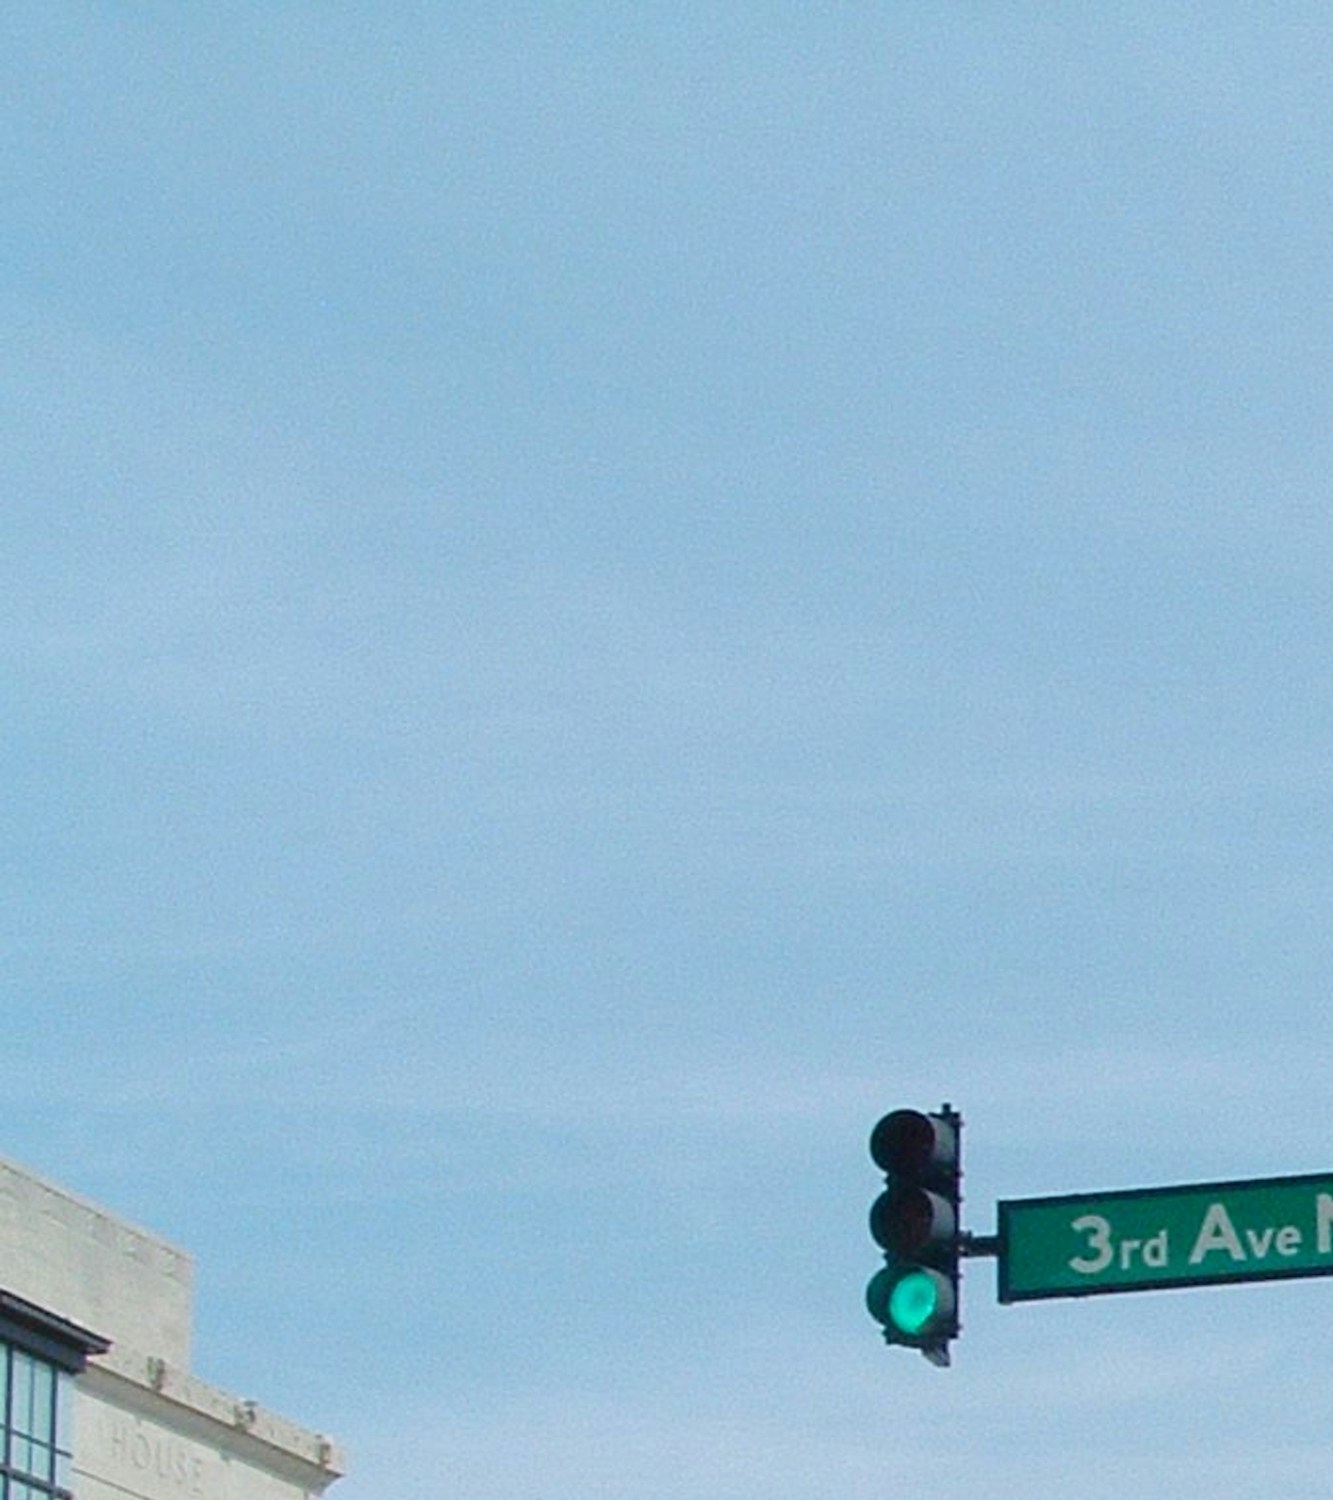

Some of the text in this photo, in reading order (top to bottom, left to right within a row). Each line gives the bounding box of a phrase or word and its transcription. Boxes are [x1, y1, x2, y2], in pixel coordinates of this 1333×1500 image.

[1068, 1214, 1168, 1274] 3rd
[1189, 1203, 1302, 1264] Ave
[110, 1419, 204, 1495] HOUSE
